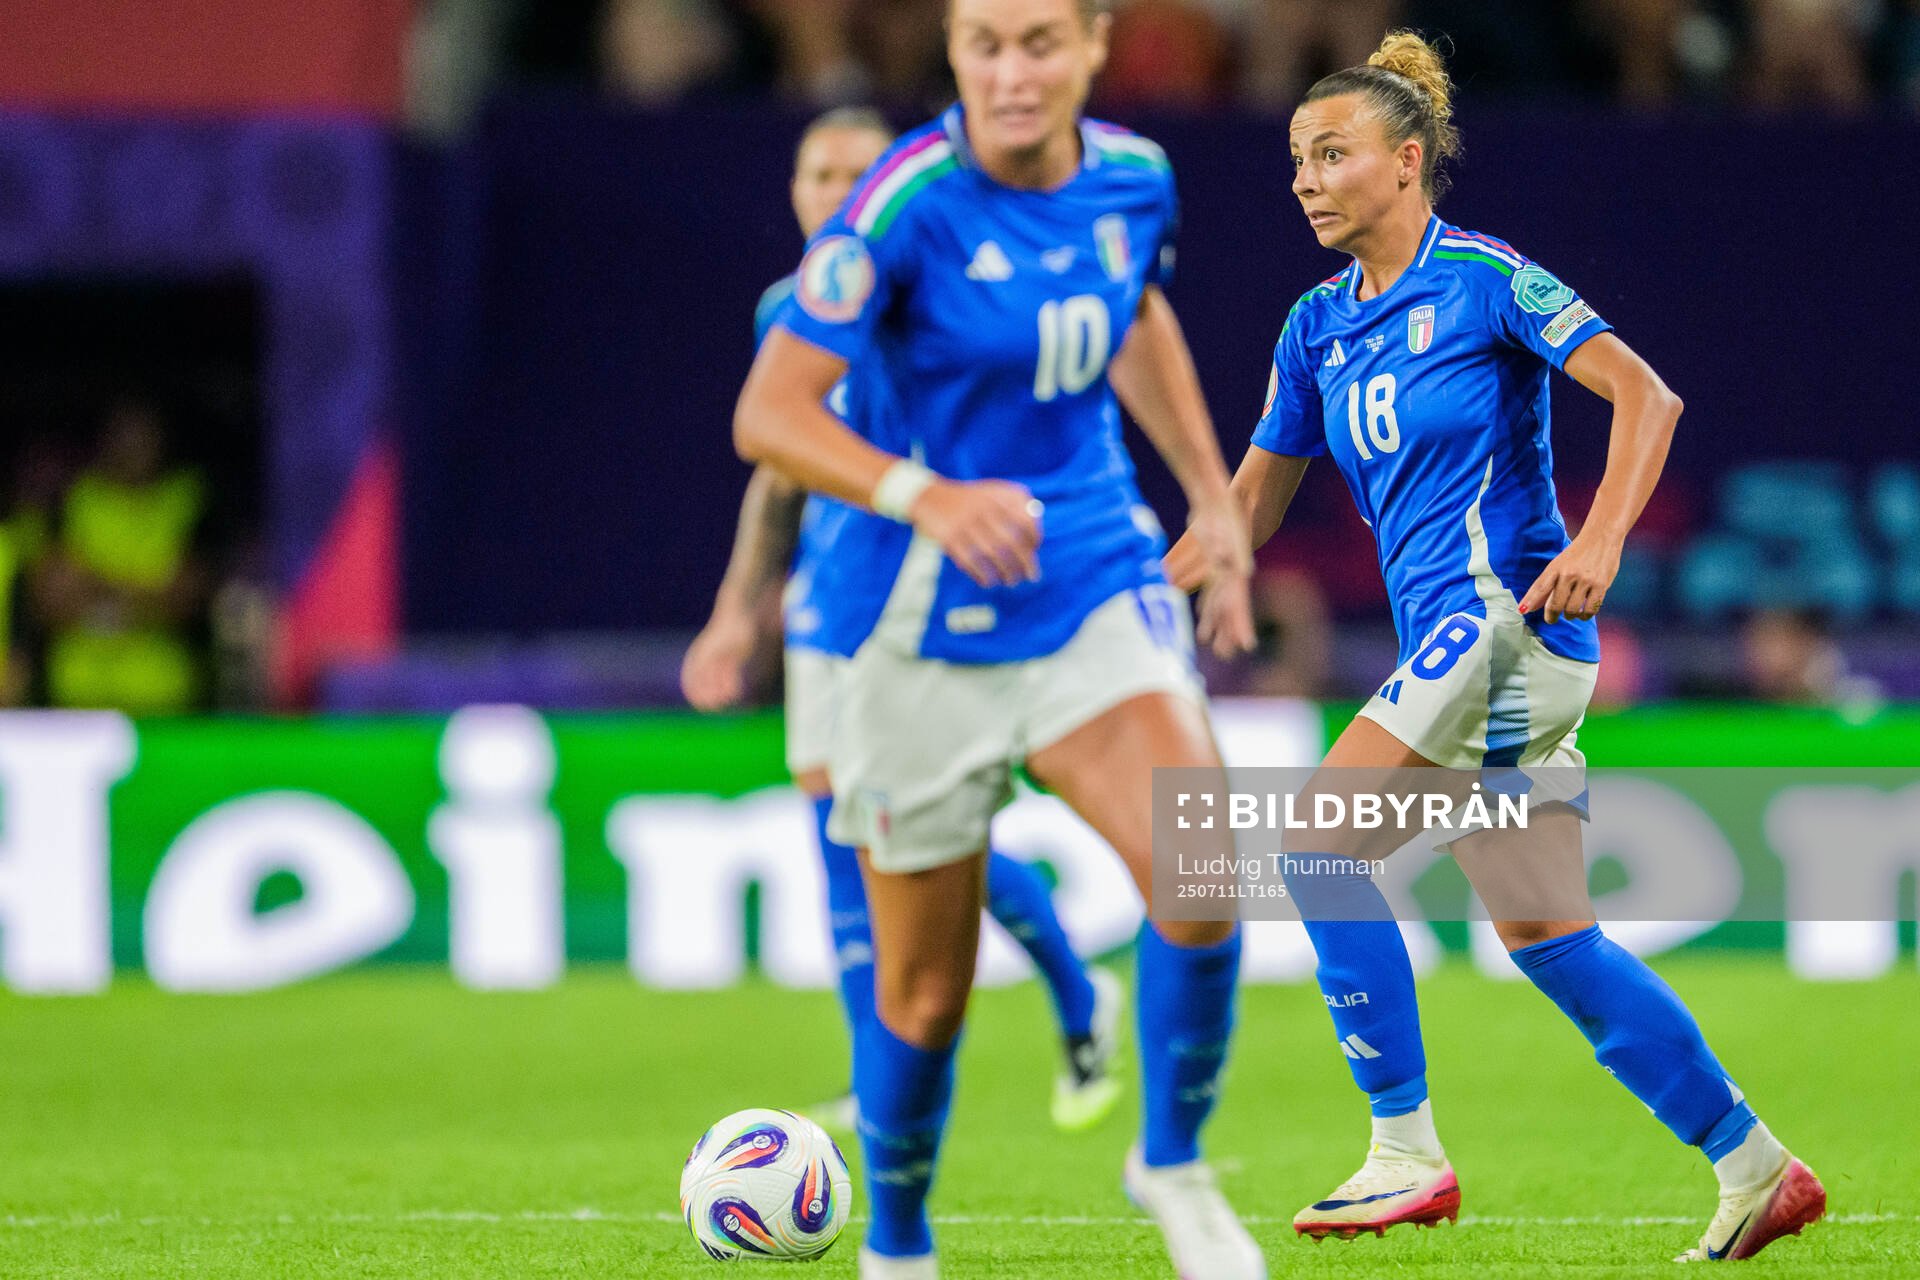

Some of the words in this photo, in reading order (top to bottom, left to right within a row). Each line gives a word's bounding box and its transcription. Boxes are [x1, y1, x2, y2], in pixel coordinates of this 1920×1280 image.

[1034, 294, 1110, 402] 10
[1410, 309, 1433, 321] ITALIA
[1348, 373, 1400, 460] 18
[1411, 615, 1480, 681] 8
